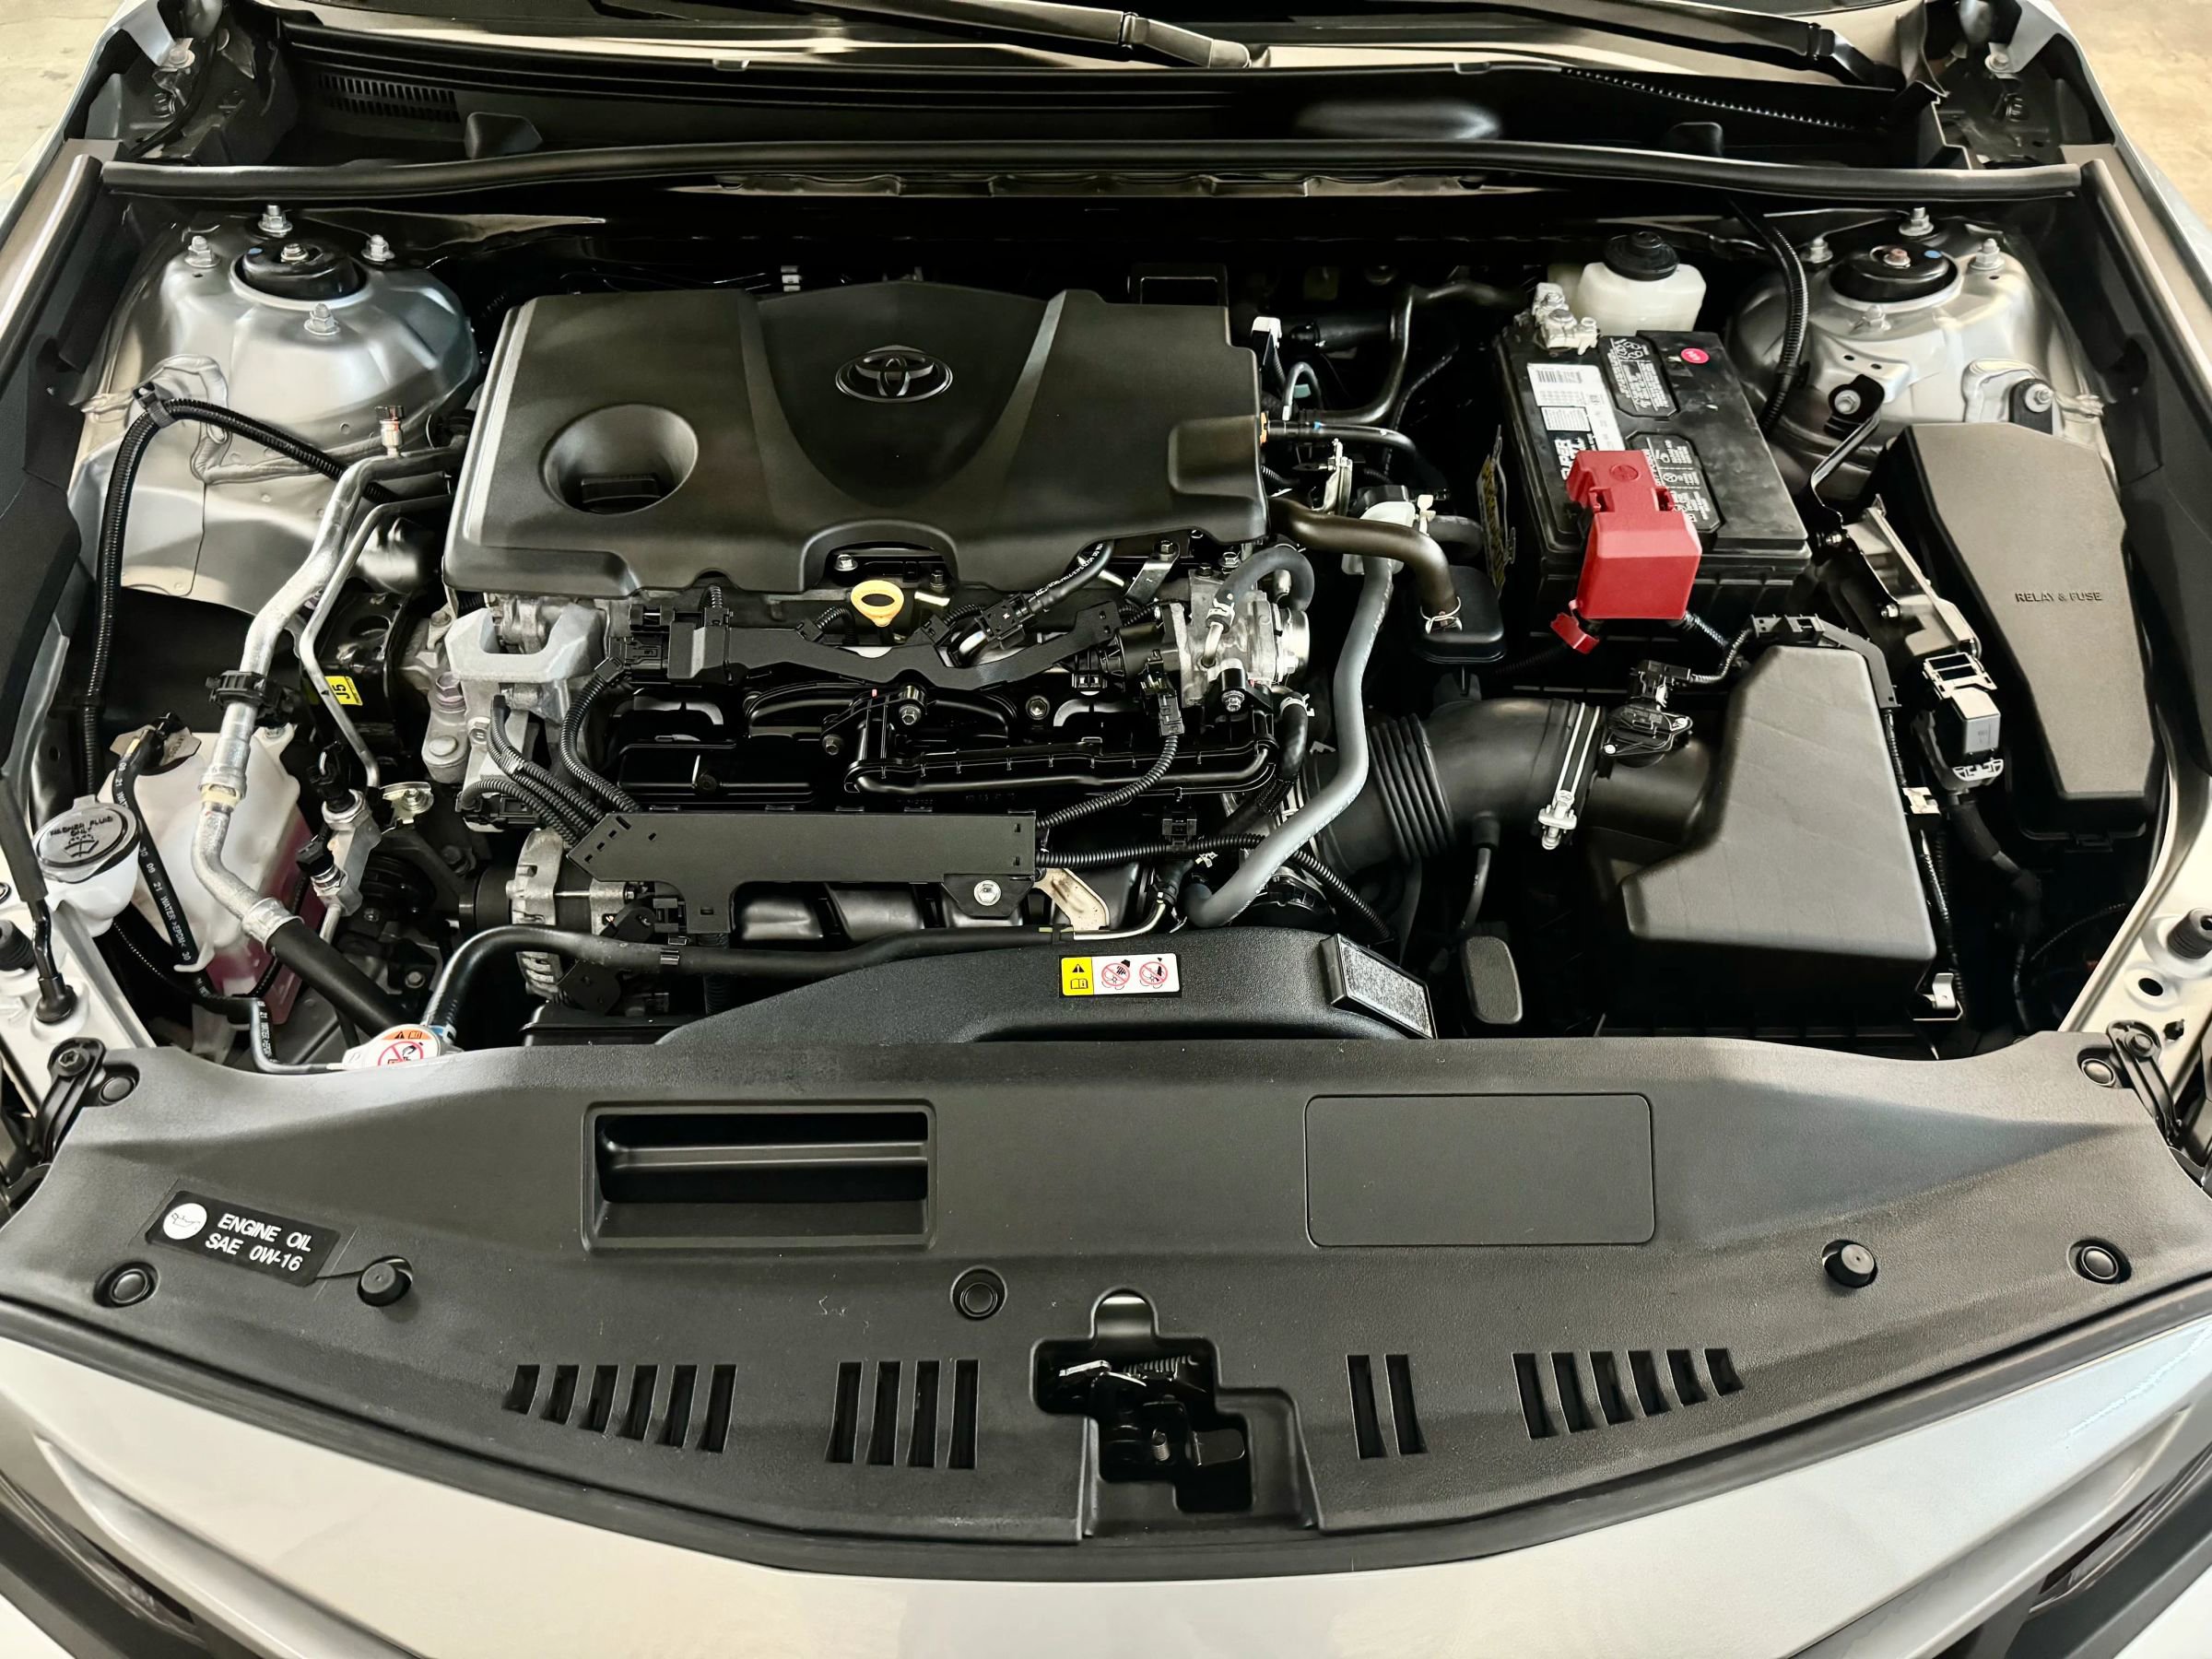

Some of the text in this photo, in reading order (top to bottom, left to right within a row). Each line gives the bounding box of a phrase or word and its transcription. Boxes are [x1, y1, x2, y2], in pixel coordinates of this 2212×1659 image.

[2015, 591, 2102, 603] RELAY & FUSE
[332, 684, 350, 700] J5
[116, 791, 129, 808] WAT
[89, 816, 113, 827] FLUID
[153, 881, 163, 892] 21
[160, 895, 176, 921] WATER
[217, 1213, 312, 1253] ENGINE OIL
[205, 1232, 303, 1272] SAE 0W-16
